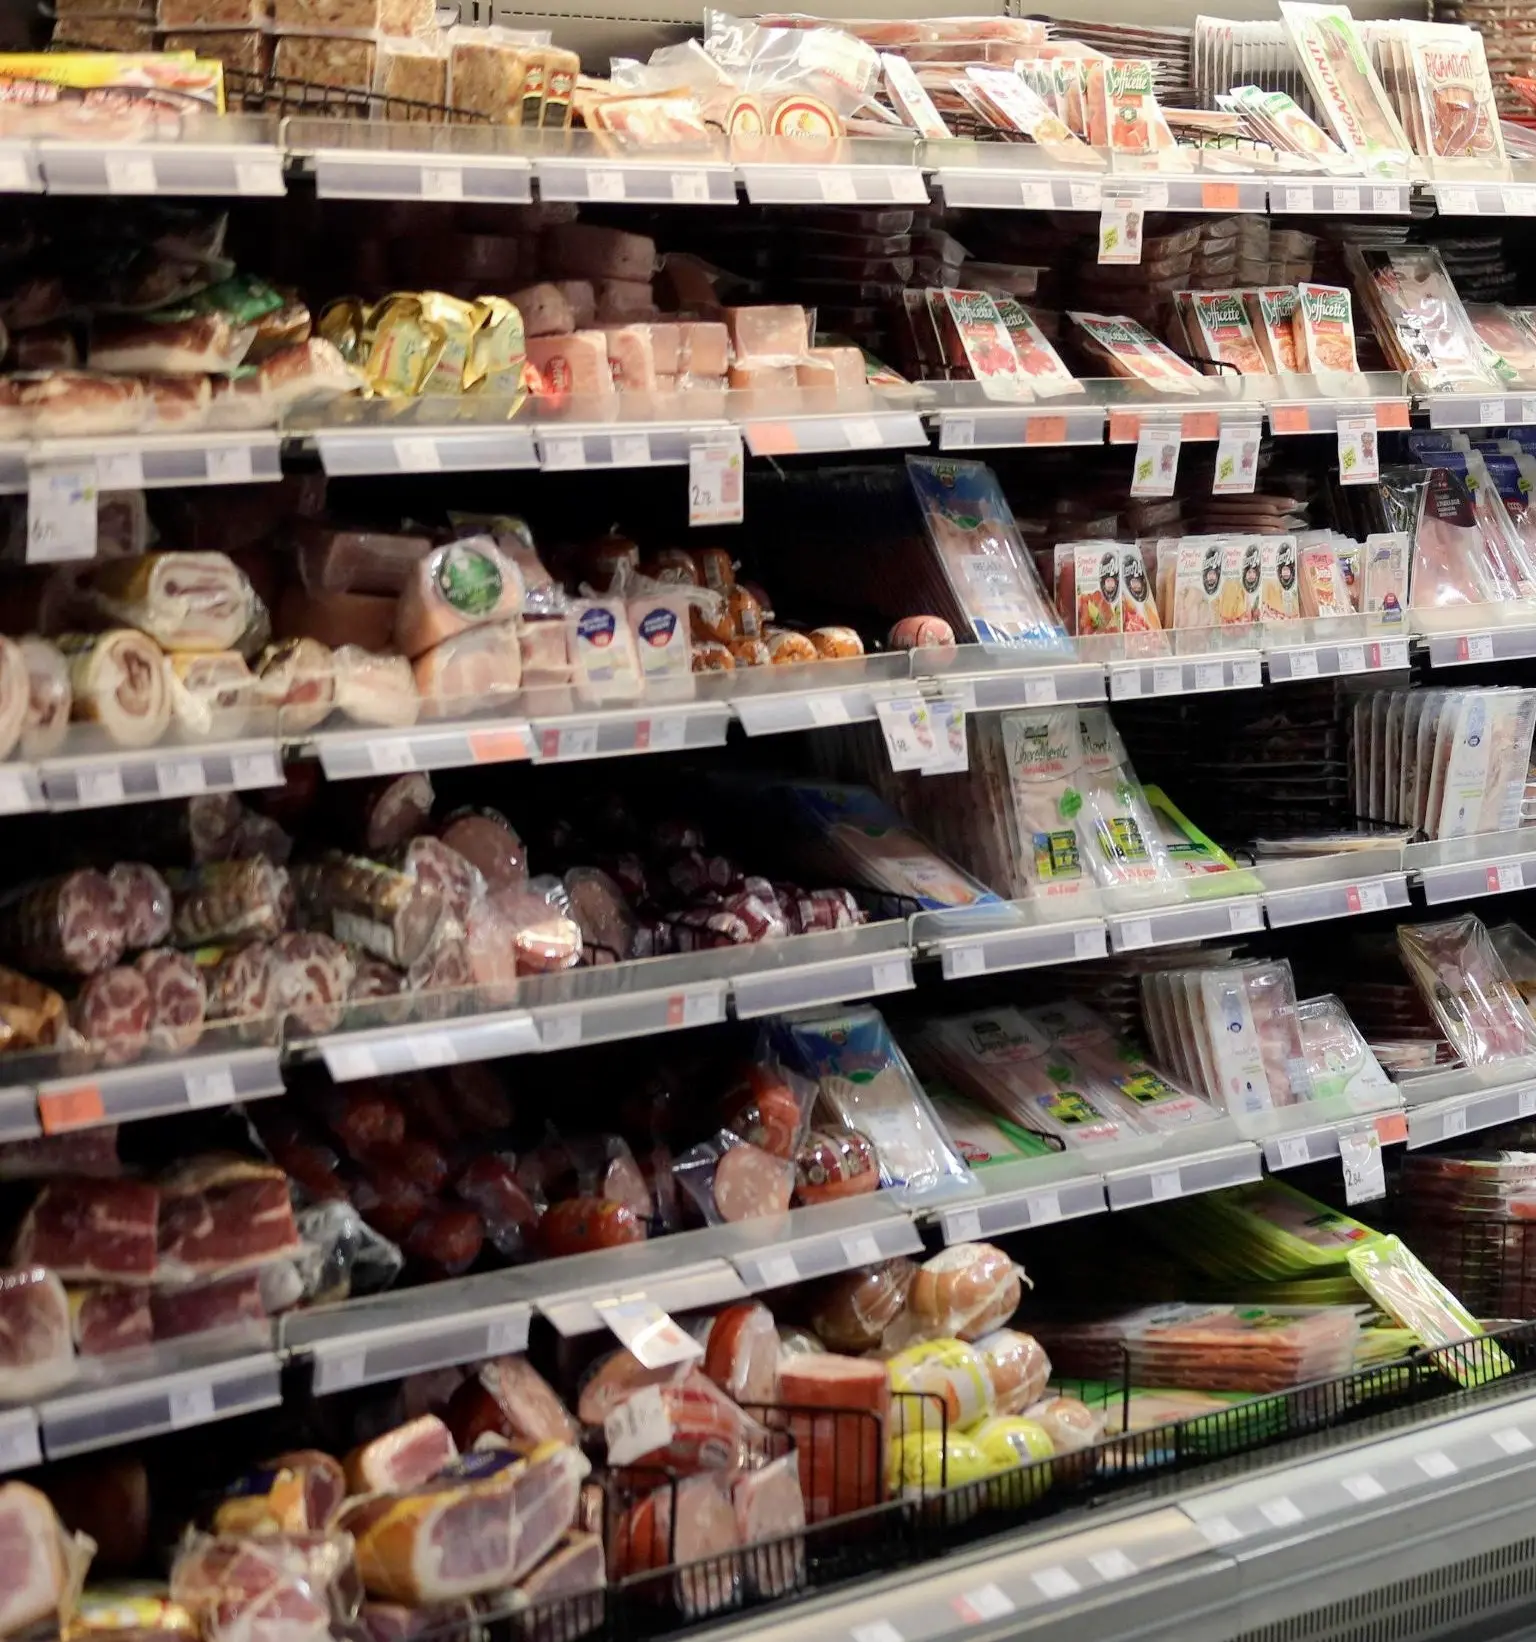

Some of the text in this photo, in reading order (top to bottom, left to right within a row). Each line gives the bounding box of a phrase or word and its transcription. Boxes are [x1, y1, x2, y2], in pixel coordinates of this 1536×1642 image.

[1424, 52, 1474, 80] RIGAMONTI
[1307, 38, 1366, 148] RIGAMONTI
[1200, 297, 1241, 332] Sofficette
[1264, 294, 1295, 327] Sofficett
[1303, 291, 1347, 325] Sofficette
